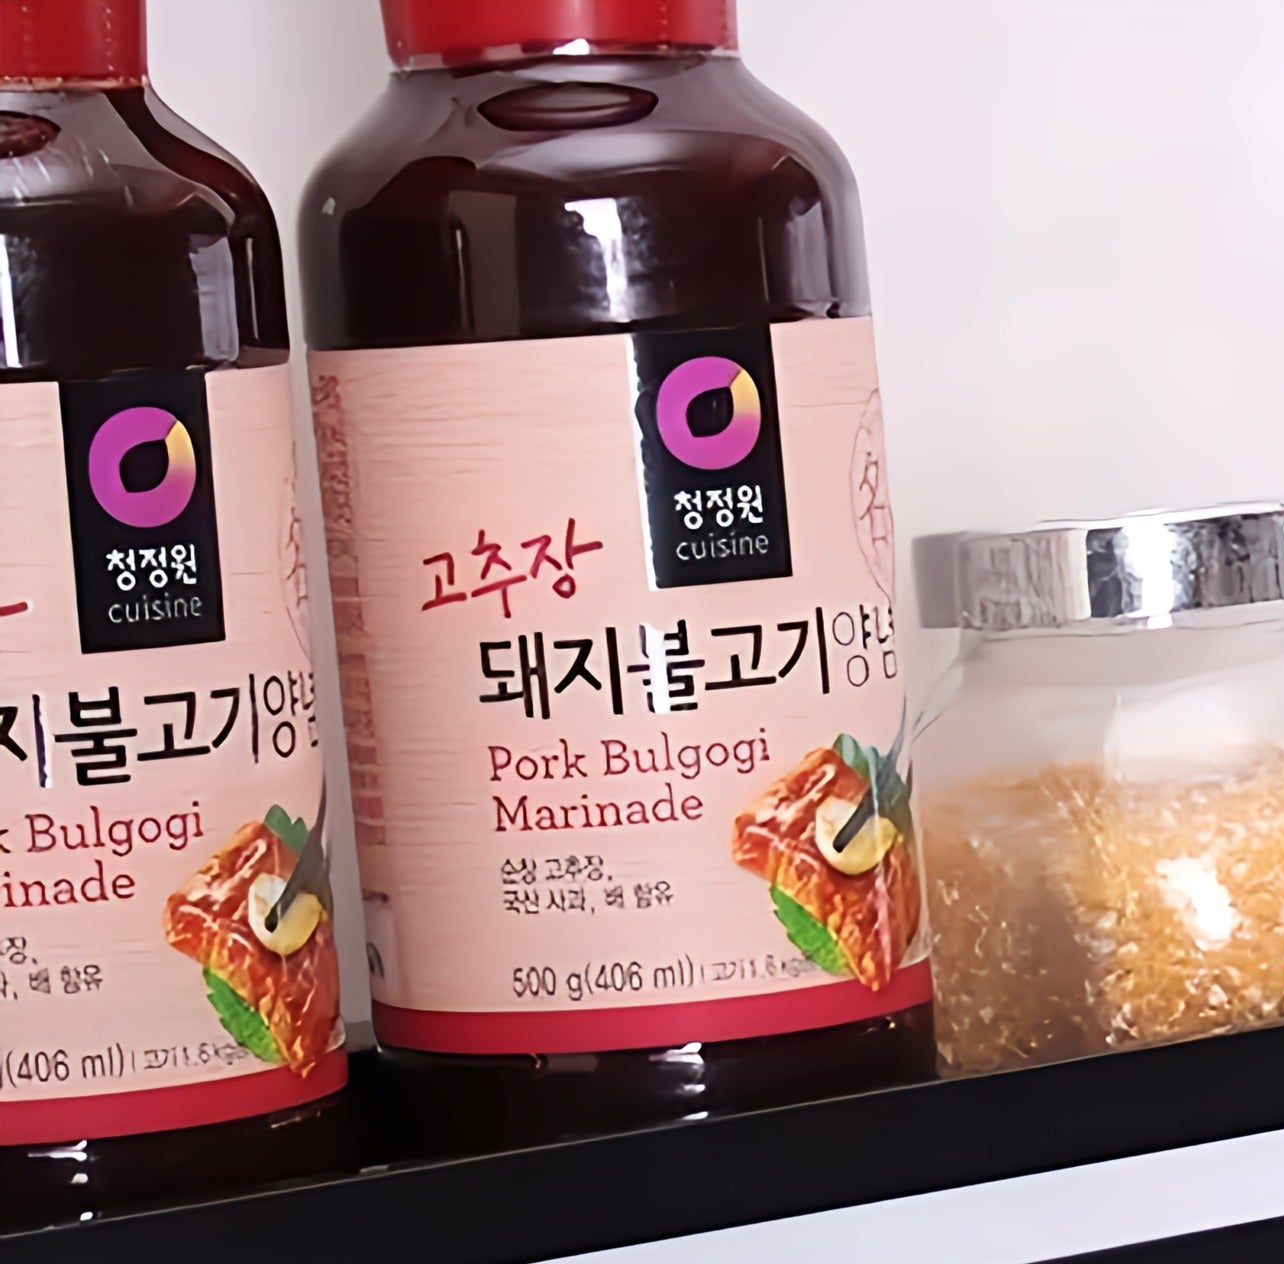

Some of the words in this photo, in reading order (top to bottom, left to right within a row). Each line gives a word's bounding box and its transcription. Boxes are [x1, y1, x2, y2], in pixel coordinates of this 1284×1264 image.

[673, 483, 765, 530] 청정원
[105, 544, 198, 591] 청정원
[421, 517, 603, 619] 고추장
[675, 532, 770, 563] cuisine
[107, 593, 204, 624] cuisine
[488, 738, 589, 782] Pork
[601, 727, 771, 779] Bulgogi
[25, 800, 204, 857] Bulgogi
[493, 783, 704, 833] Marinade
[512, 965, 557, 998] 500
